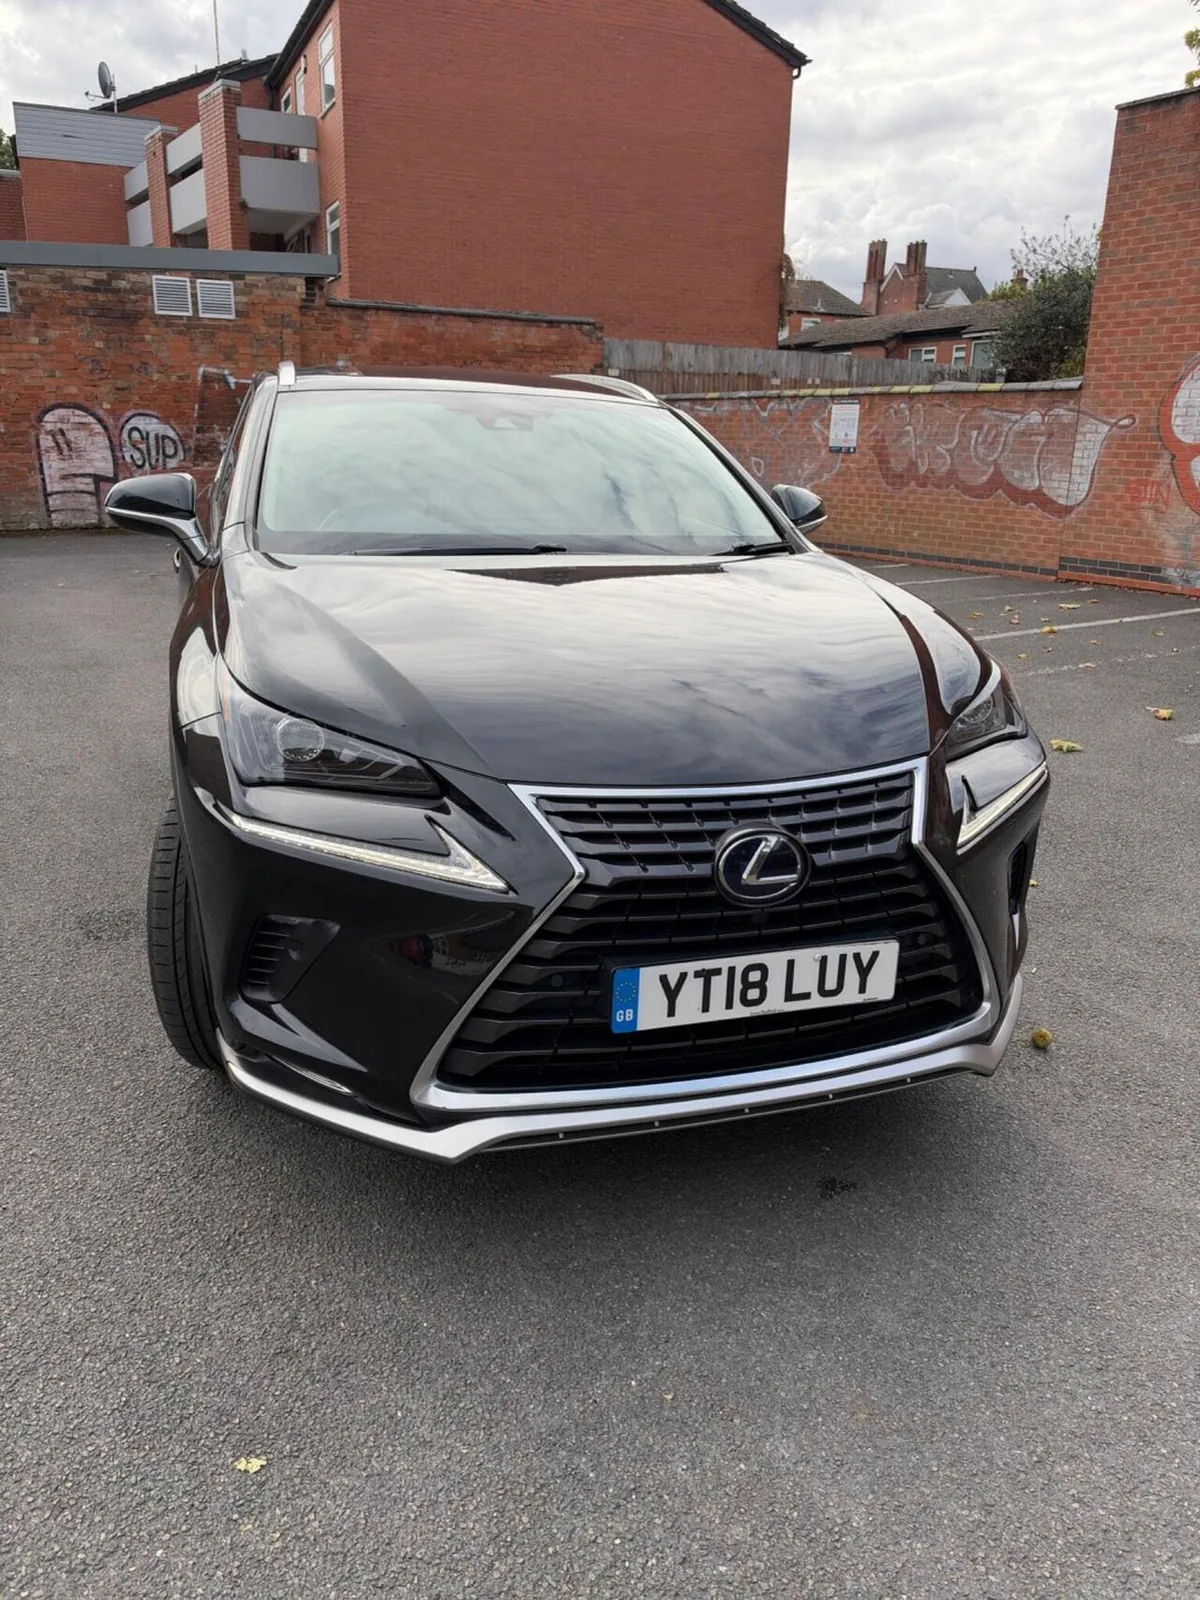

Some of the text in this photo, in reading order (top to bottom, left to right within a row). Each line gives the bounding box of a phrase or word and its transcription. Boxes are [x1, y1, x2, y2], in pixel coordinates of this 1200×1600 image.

[127, 426, 178, 469] SUP
[659, 950, 880, 1018] YT18 LUY
[616, 1009, 634, 1022] GB
